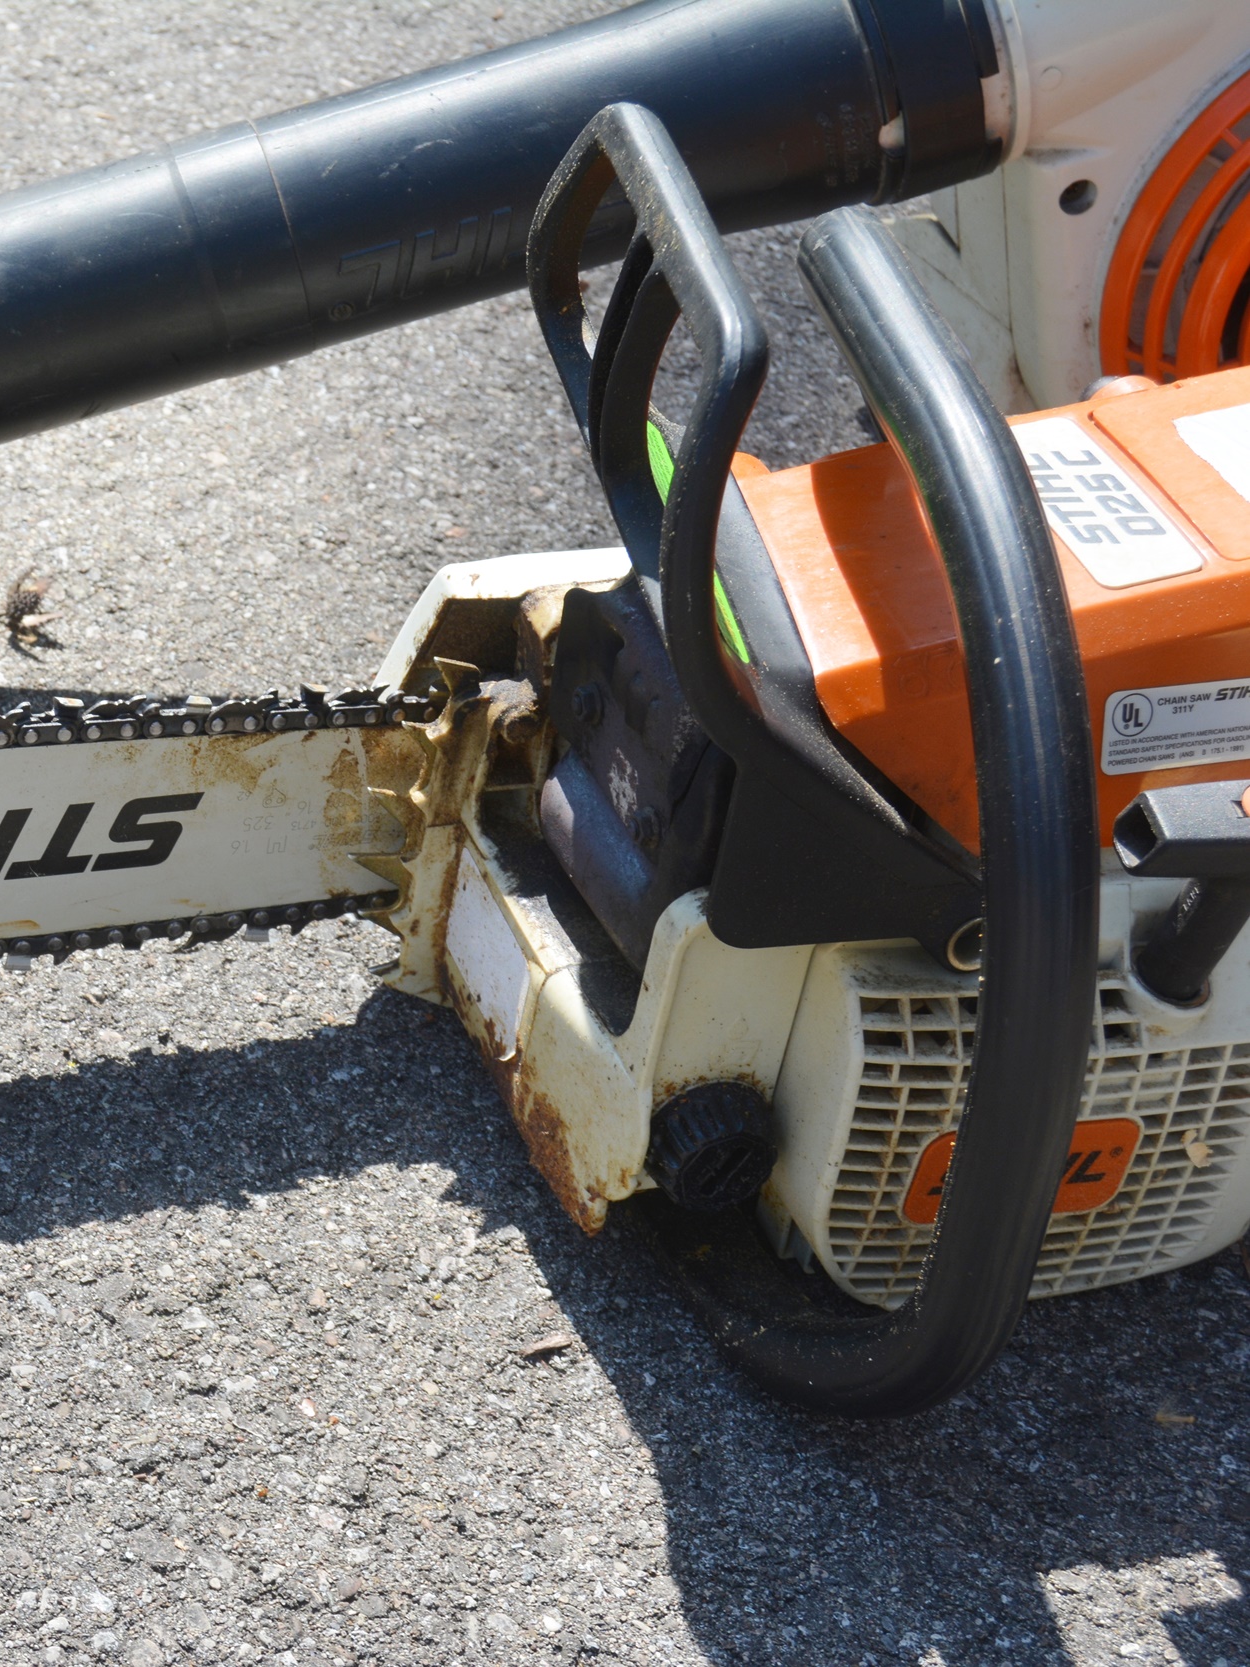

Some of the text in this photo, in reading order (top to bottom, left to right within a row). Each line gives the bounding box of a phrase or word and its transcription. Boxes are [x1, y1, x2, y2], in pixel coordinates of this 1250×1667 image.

[1029, 453, 1121, 544] STIHL
[1074, 473, 1167, 536] 025
[1157, 696, 1188, 706] CHAIN
[1190, 693, 1212, 703] SAW
[1122, 702, 1144, 728] UL
[1172, 704, 1195, 715] 311Y
[1109, 739, 1130, 747] LISTED
[1138, 733, 1179, 744] ACCORDANCE
[1180, 731, 1195, 739] WITH
[1196, 728, 1226, 737] AMERICAN
[1108, 747, 1140, 757] STANDARD
[1141, 745, 1164, 753] SAFETY
[1165, 739, 1212, 750] SPECIFICATIONS
[1107, 757, 1138, 767] POWERED
[1139, 755, 1157, 764] CHAIN
[1158, 752, 1175, 761] SAWS
